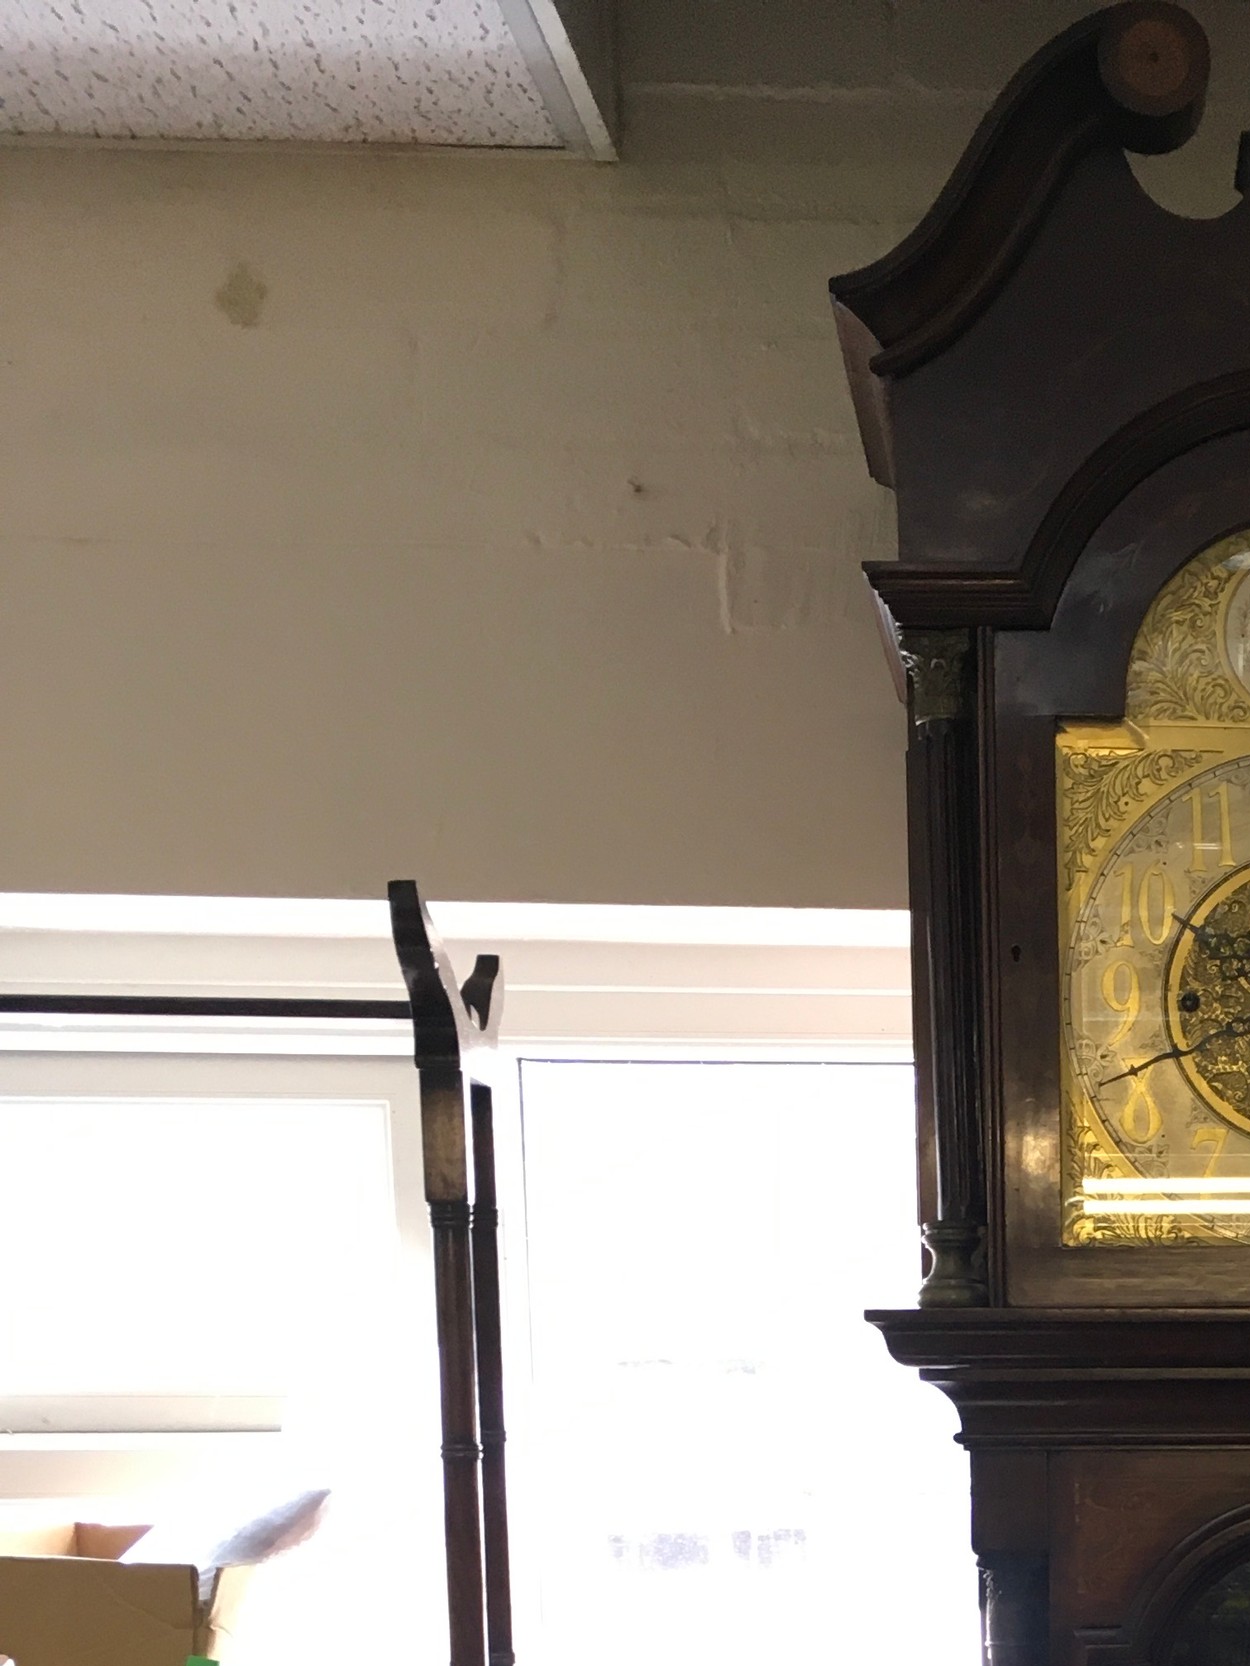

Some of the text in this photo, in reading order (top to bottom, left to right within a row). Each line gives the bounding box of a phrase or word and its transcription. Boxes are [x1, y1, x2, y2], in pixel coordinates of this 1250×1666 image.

[1182, 782, 1237, 873] 11
[1113, 863, 1176, 947] 10
[1102, 961, 1141, 1047] 9
[1119, 1056, 1163, 1144] 8
[1190, 1127, 1231, 1203] 7
